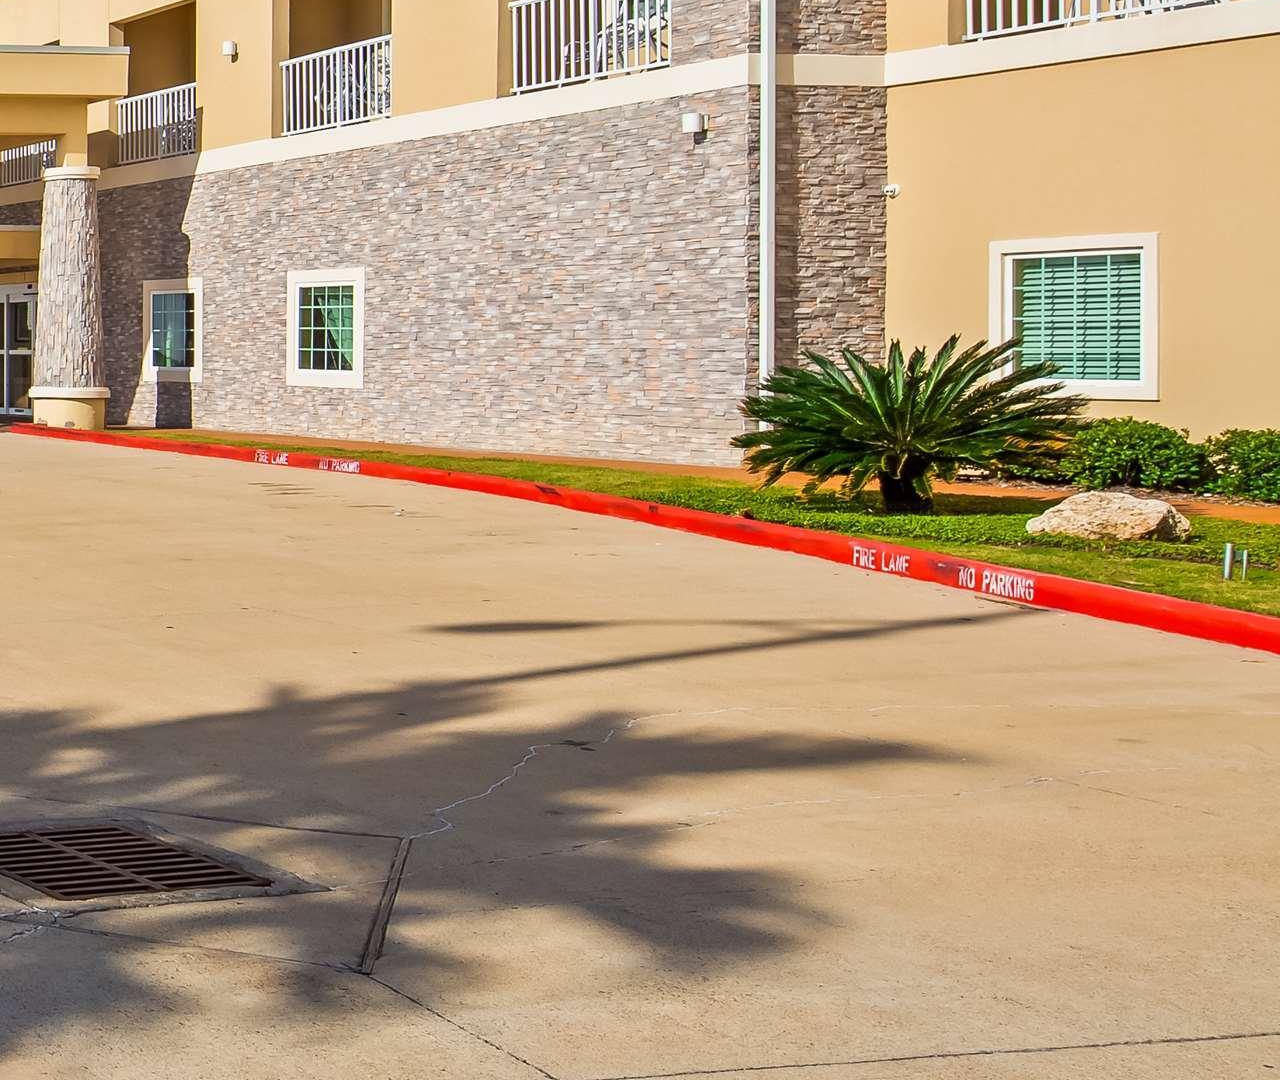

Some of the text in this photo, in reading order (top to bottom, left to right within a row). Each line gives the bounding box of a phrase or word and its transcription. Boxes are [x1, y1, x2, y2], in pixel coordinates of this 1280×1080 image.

[853, 545, 911, 575] FIRE LANE
[958, 566, 1034, 601] NO PARKING
